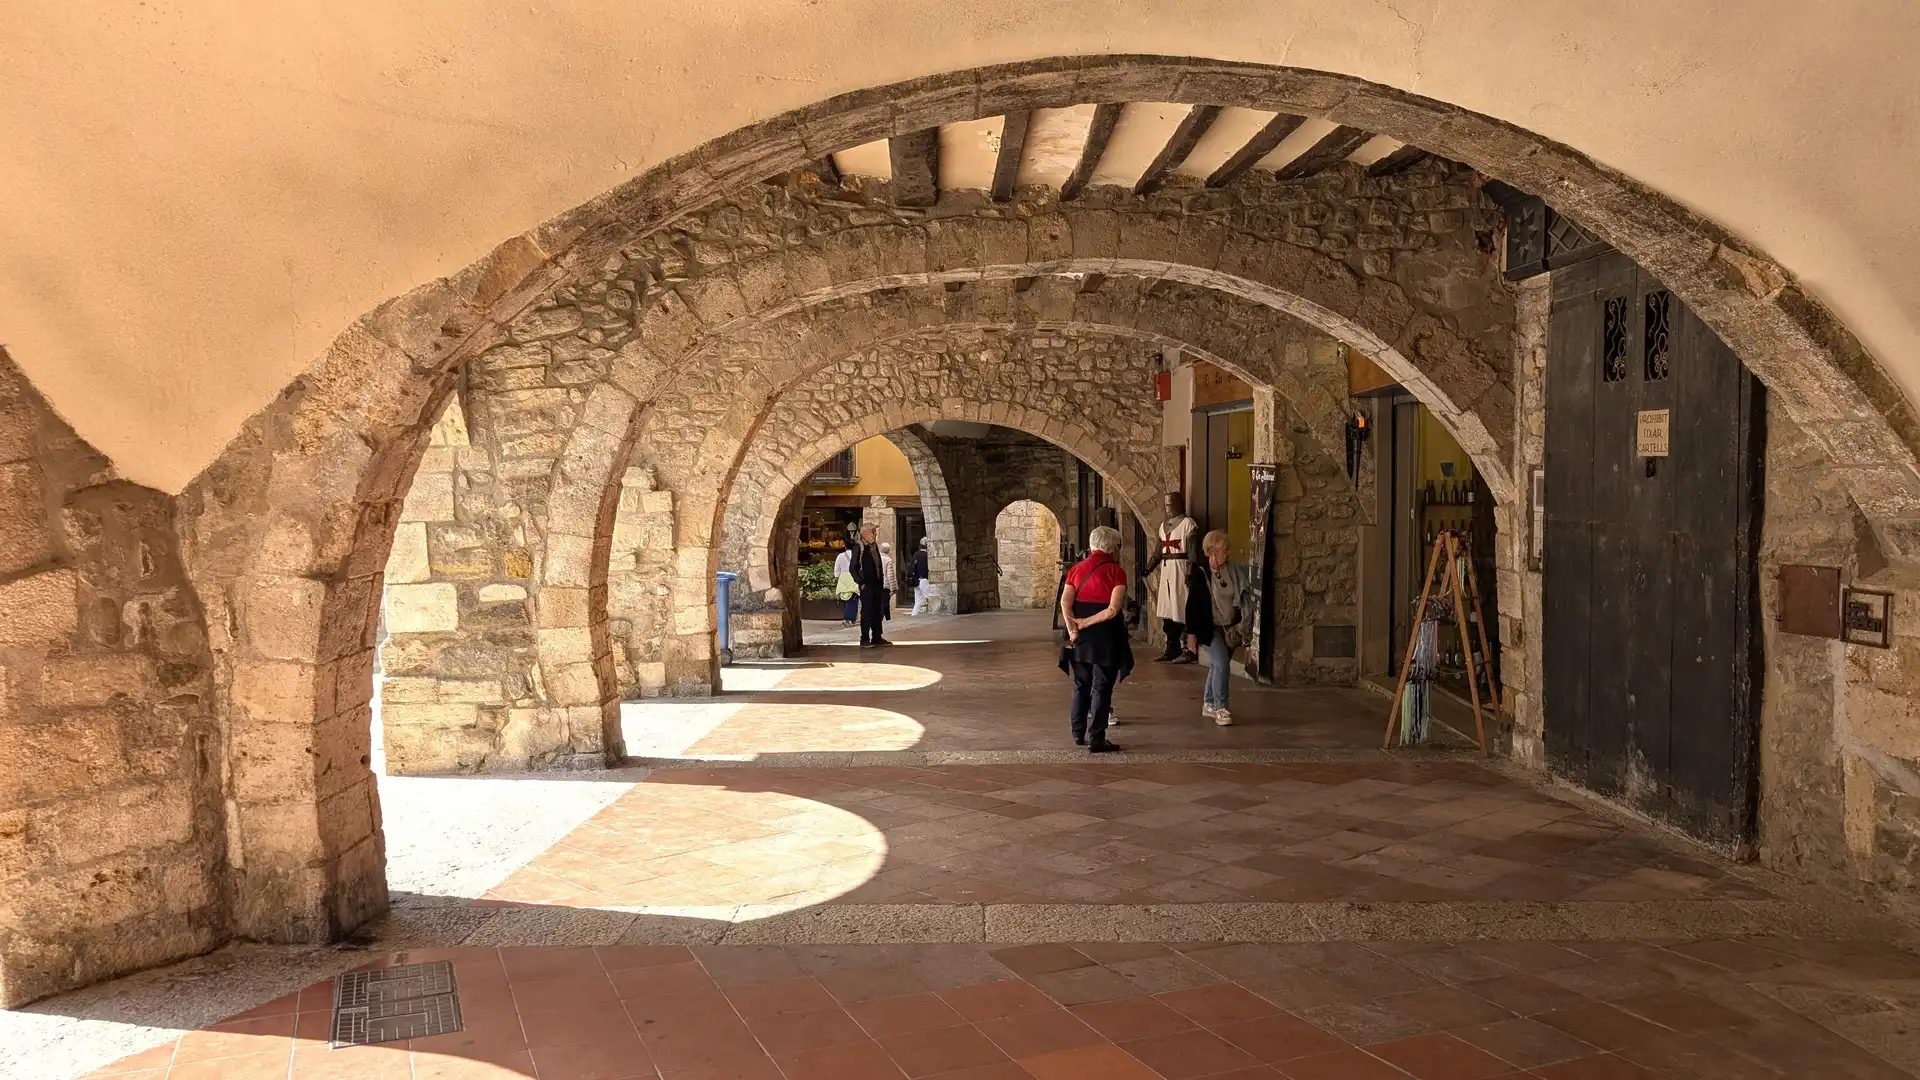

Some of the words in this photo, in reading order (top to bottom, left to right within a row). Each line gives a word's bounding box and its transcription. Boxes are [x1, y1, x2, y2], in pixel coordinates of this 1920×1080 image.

[1639, 413, 1668, 424] PROHIBIT
[1643, 428, 1663, 439] FIXAR
[1637, 442, 1668, 453] CARTELLS
